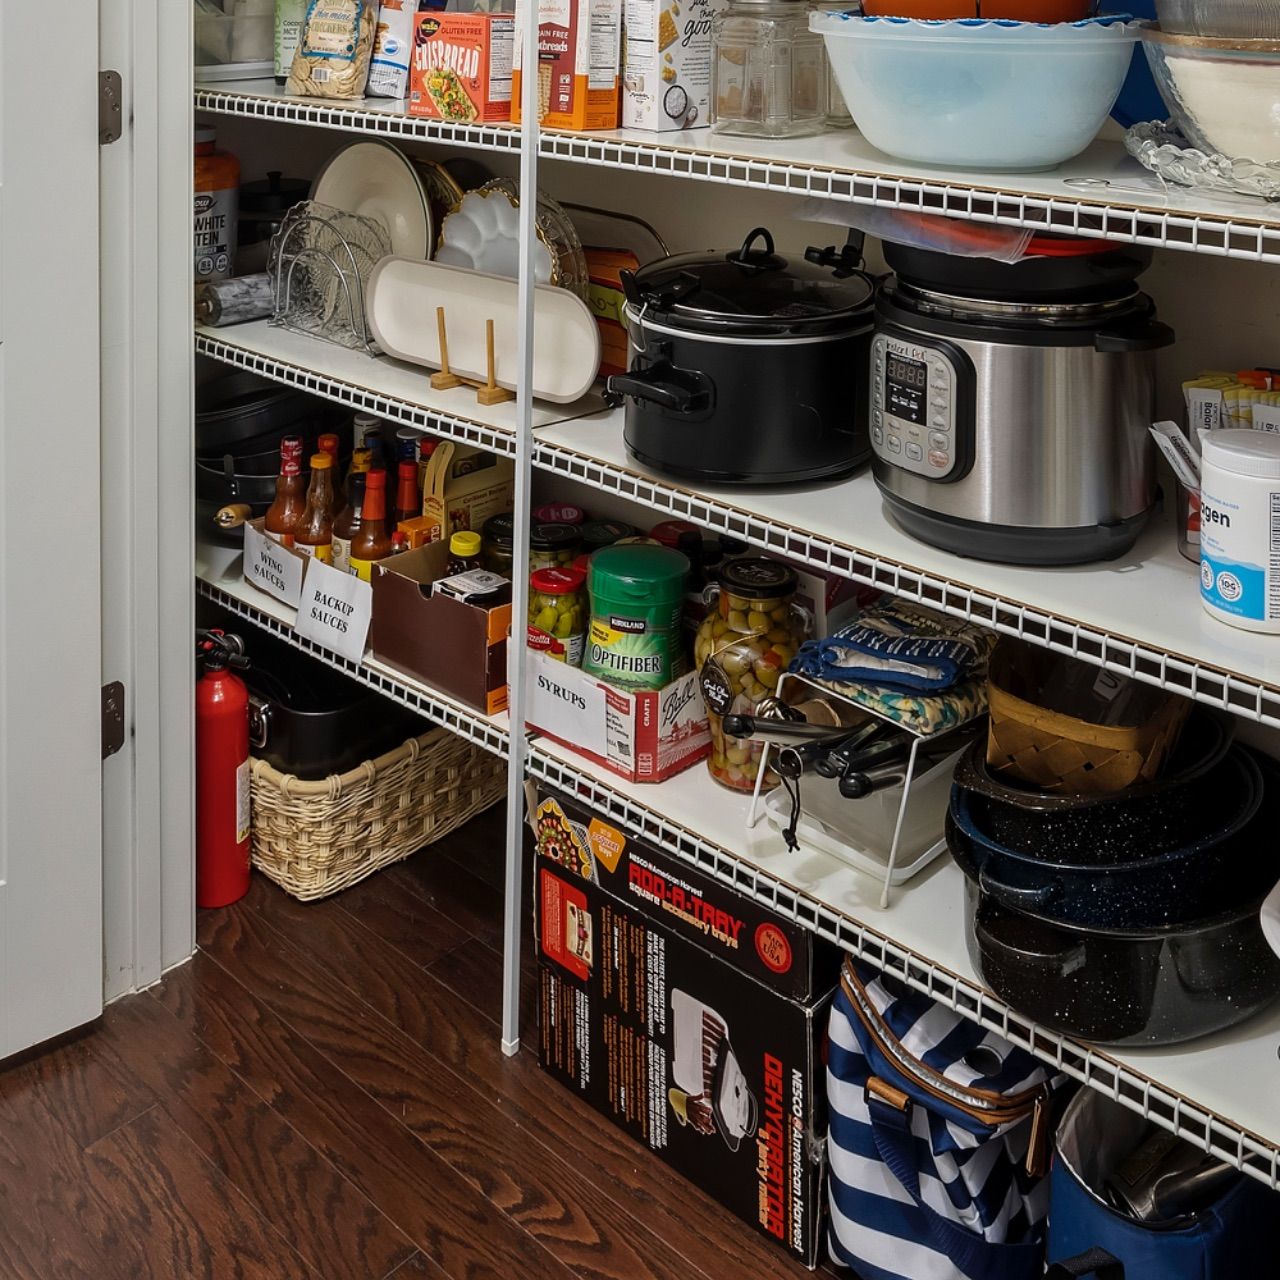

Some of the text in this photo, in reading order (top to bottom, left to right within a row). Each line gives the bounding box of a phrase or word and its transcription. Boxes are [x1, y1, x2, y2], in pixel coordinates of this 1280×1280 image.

[440, 26, 483, 36] GLUTEN FREE
[552, 30, 569, 39] FREE
[260, 551, 283, 574] WING
[254, 564, 286, 592] SAUCES
[313, 590, 355, 617] BACKUP
[310, 607, 348, 634] SAUCES
[611, 617, 645, 630] KIRKLAND
[592, 643, 662, 673] OPTIFIBER
[537, 675, 587, 710] SYRUPS
[662, 675, 696, 726] Ball
[629, 852, 703, 898] NESCO American Harvest
[629, 882, 660, 906] square
[763, 946, 781, 964] USA
[756, 1138, 769, 1181] jerky
[764, 1053, 784, 1240] DEHYDRATOR
[792, 1068, 805, 1252] NESCO American Harvest
